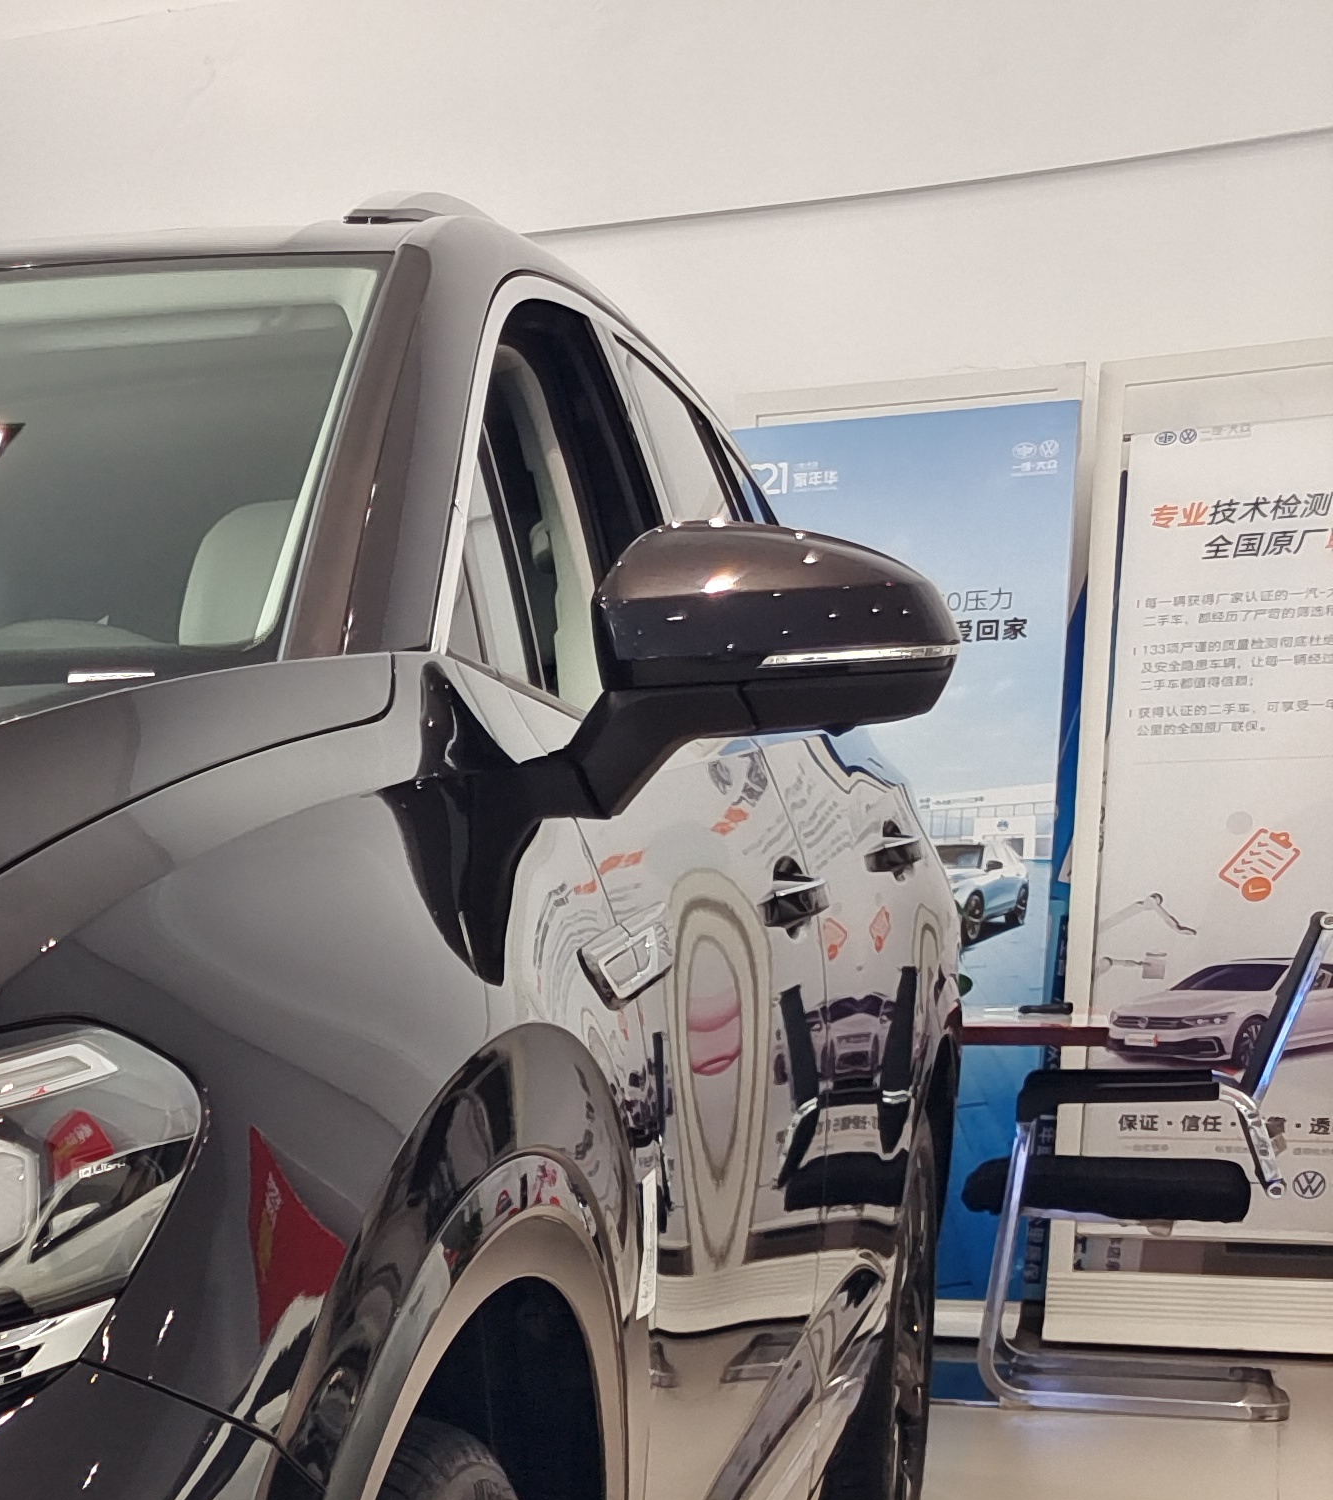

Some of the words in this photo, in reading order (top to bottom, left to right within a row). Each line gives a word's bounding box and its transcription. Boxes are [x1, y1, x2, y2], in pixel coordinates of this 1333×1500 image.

[1151, 492, 1333, 528] 专业技术检测
[1200, 527, 1333, 560] 全国原厂
